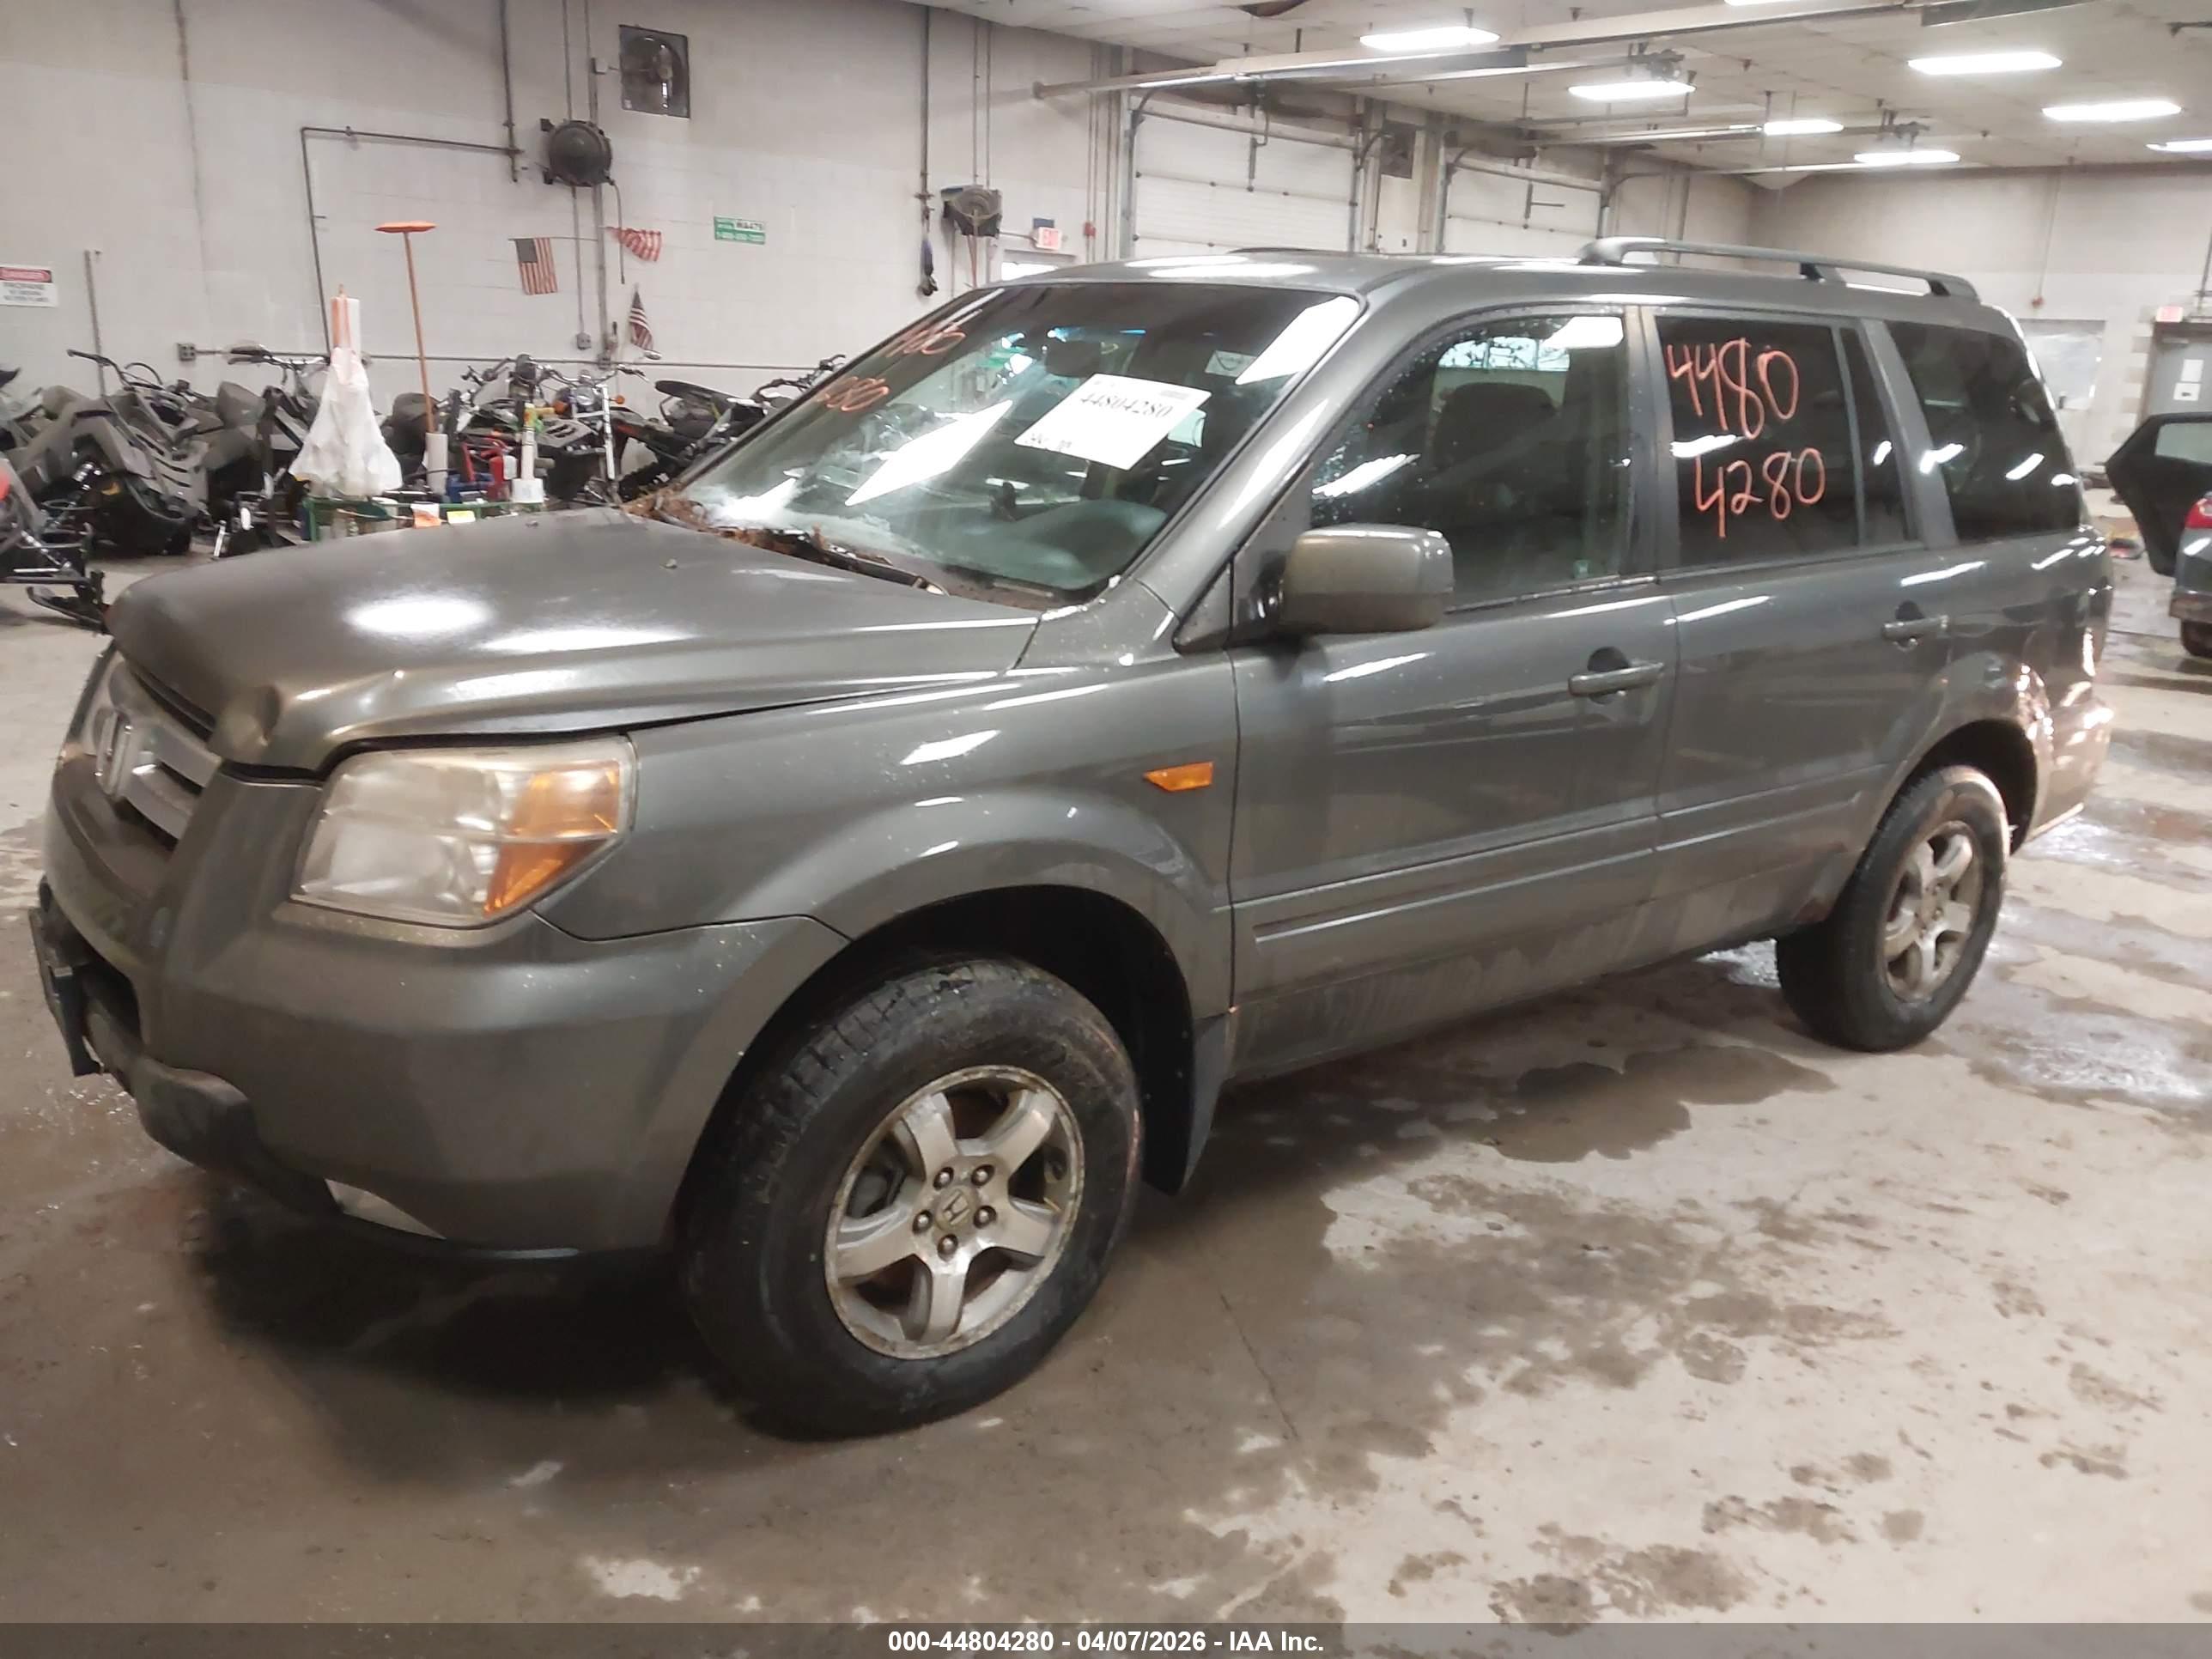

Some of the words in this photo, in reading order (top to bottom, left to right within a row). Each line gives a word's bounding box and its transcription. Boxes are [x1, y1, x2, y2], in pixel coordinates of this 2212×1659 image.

[1080, 392, 1175, 419] 44804280
[1667, 337, 1800, 440] 4480
[1694, 447, 1826, 538] 4280
